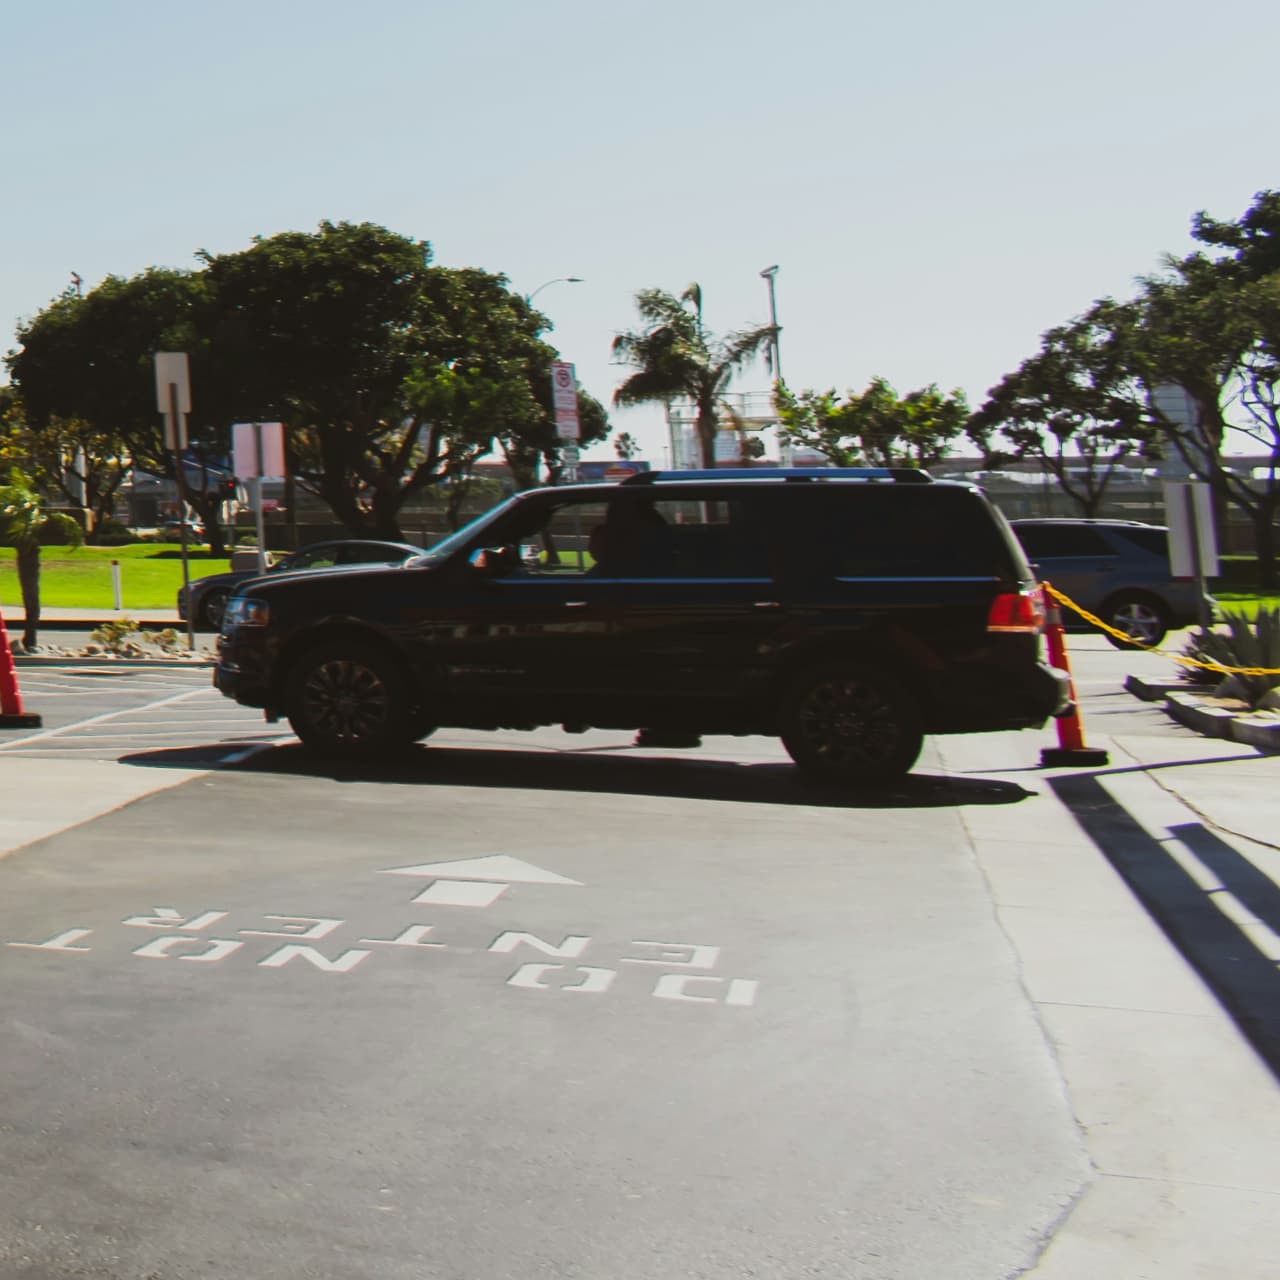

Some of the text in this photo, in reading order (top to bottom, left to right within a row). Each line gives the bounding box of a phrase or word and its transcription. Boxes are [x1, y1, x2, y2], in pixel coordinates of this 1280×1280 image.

[5, 928, 759, 1006] DO NOT
[121, 906, 720, 969] ENTER
